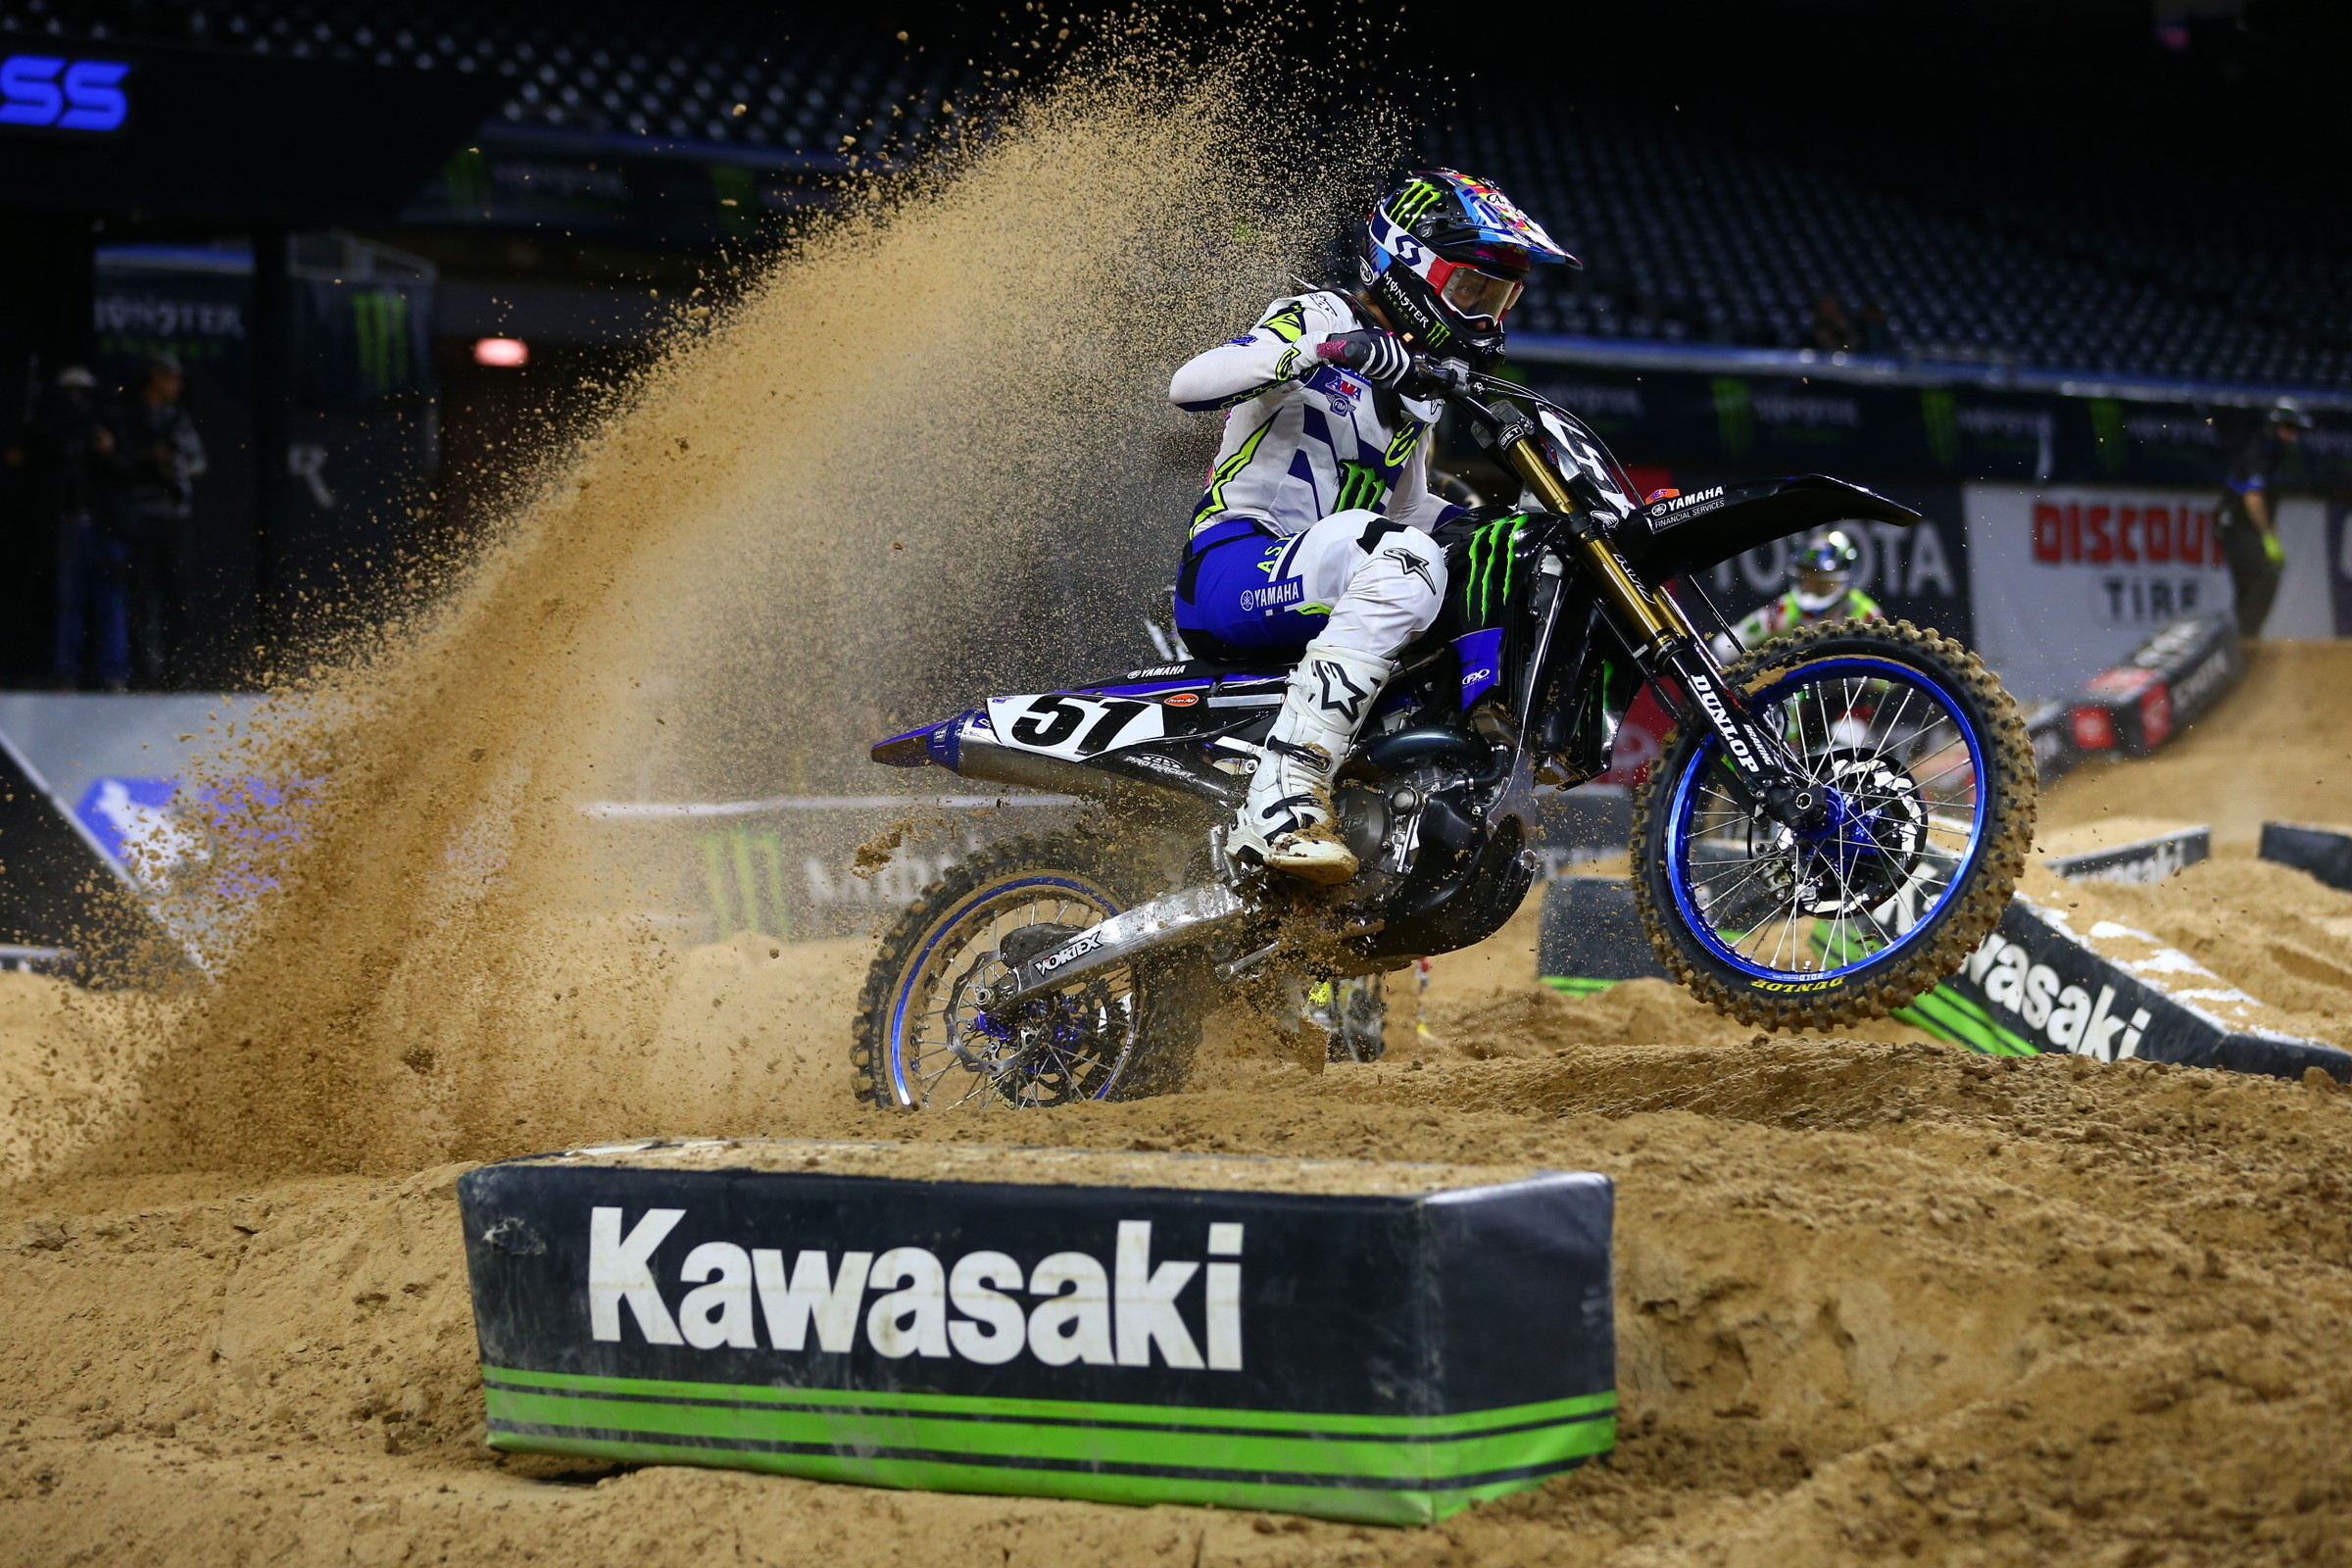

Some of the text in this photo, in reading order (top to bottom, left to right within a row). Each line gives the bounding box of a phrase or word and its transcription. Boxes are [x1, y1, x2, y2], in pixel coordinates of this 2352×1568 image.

[1384, 270, 1429, 328] MONSTER
[1325, 376, 1361, 402] AMA
[1654, 499, 1725, 529] FINANCIAL SERVICES
[1668, 486, 1724, 512] YAMAHA
[1717, 517, 1956, 596] OOTA
[1254, 581, 1299, 608] YAMAHA
[1141, 664, 1187, 678] YAMAHA
[1011, 694, 1152, 757] 51
[1690, 674, 1760, 772] DUNLOP
[1743, 723, 1775, 766] BRAKING
[1123, 756, 1197, 779] PRO CIRCUIT
[1034, 931, 1103, 977] VORTEX
[1750, 976, 1846, 993] DUNLOP
[588, 1205, 1245, 1371] Kawasaki
